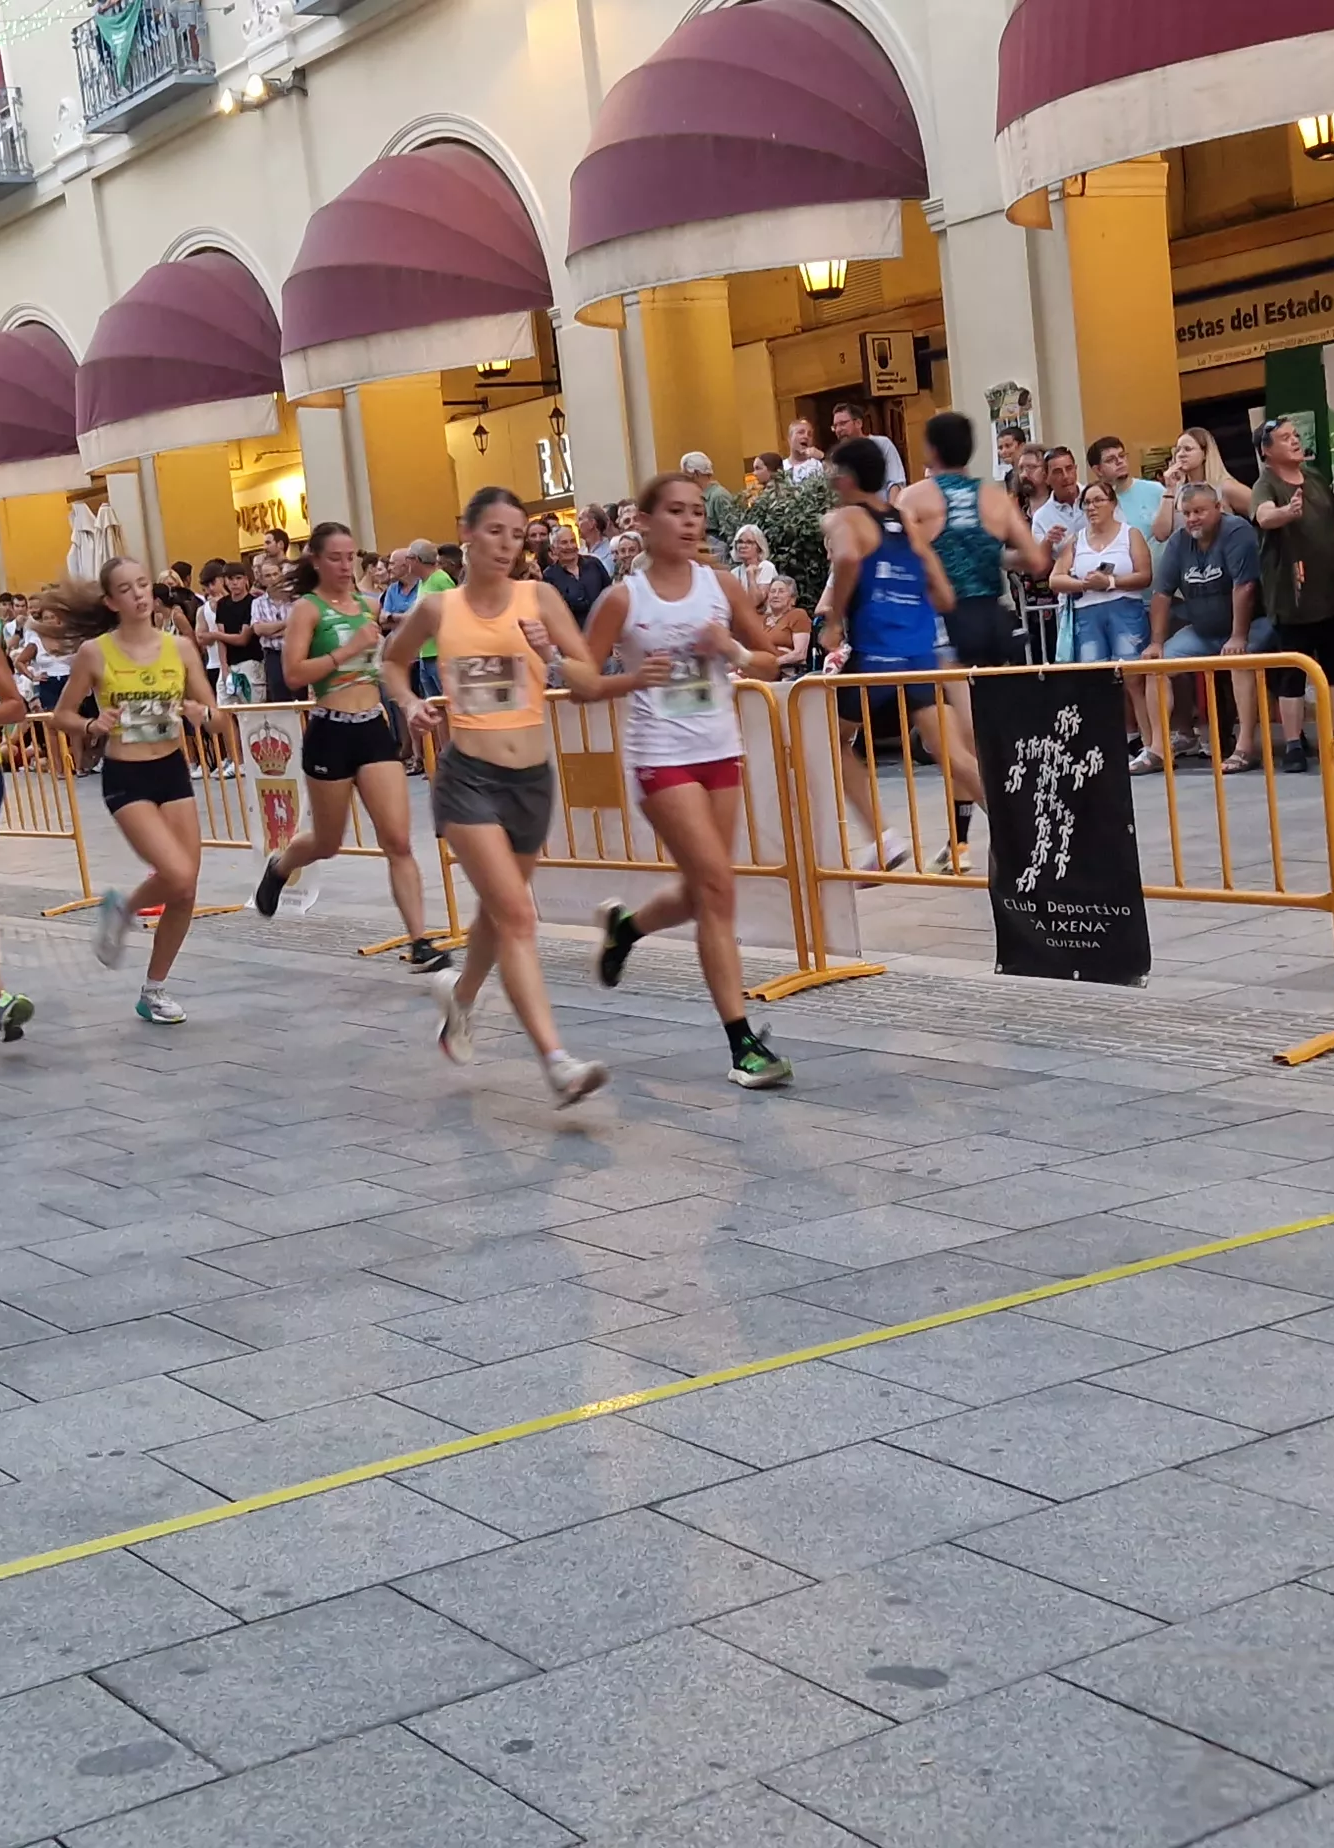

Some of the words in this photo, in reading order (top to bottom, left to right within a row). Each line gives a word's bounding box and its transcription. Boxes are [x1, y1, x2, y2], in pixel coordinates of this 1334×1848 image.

[1176, 318, 1225, 343] estas
[1230, 303, 1259, 332] del
[1264, 290, 1334, 325] Estado
[467, 657, 504, 677] 24
[140, 700, 164, 716] 26
[1003, 898, 1037, 913] Club
[1047, 900, 1131, 916] Deportivo
[1045, 938, 1101, 949] QUIZENA
